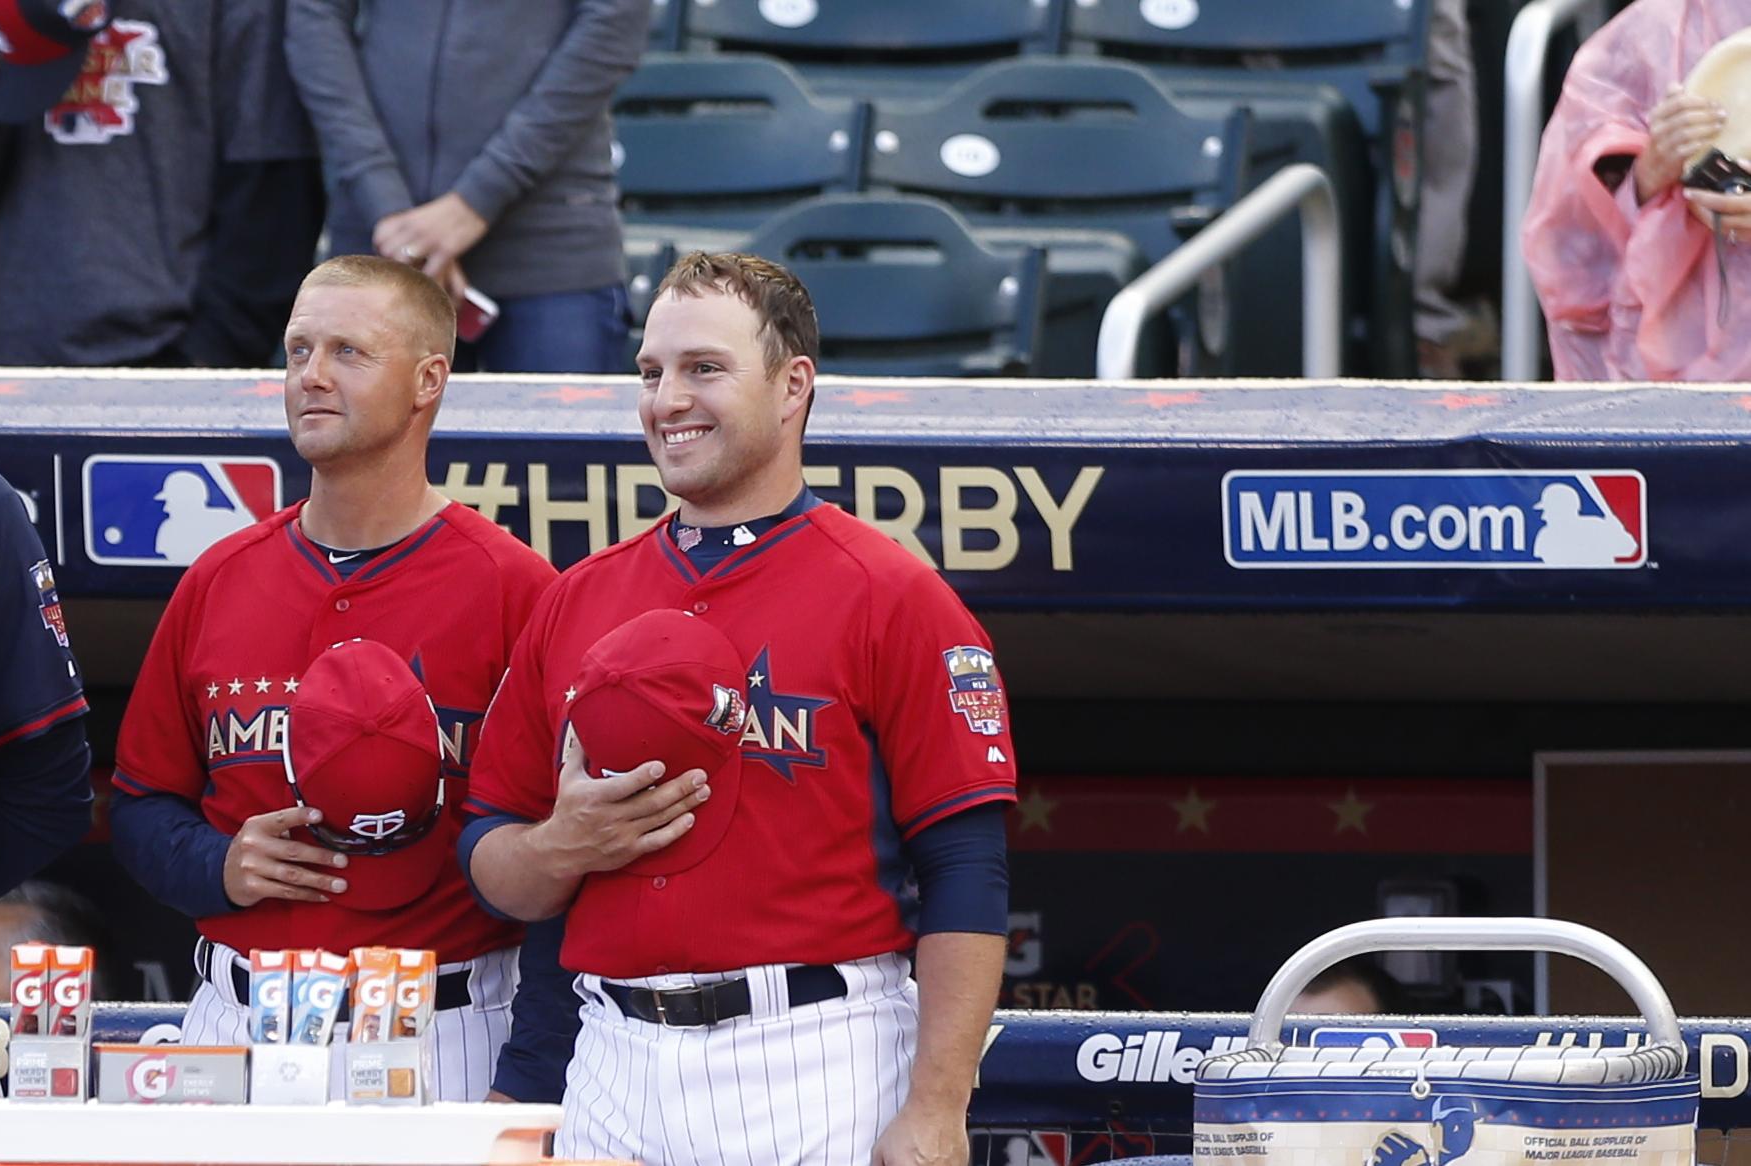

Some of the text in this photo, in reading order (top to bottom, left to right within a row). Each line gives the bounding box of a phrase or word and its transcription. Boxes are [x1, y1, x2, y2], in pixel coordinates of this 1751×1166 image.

[1238, 490, 1526, 551] MLB.com
[957, 692, 980, 706] ALL
[15, 976, 42, 1008] G
[54, 976, 80, 1008] G
[258, 979, 283, 1009] G
[309, 980, 336, 1009] G
[361, 979, 386, 1008] G
[396, 980, 420, 1009] G
[15, 1068, 47, 1076] ENERGY
[18, 1077, 46, 1085] CHEWS
[133, 1059, 167, 1100] G
[351, 1070, 383, 1078] ENERGY
[354, 1079, 383, 1087] CHEWS
[1260, 1132, 1274, 1142] OF
[1524, 1135, 1648, 1148] OFFICIAL BALL SUPPLIER OF
[1525, 1148, 1639, 1160] MAJOR LEAGUE BASEBALL
